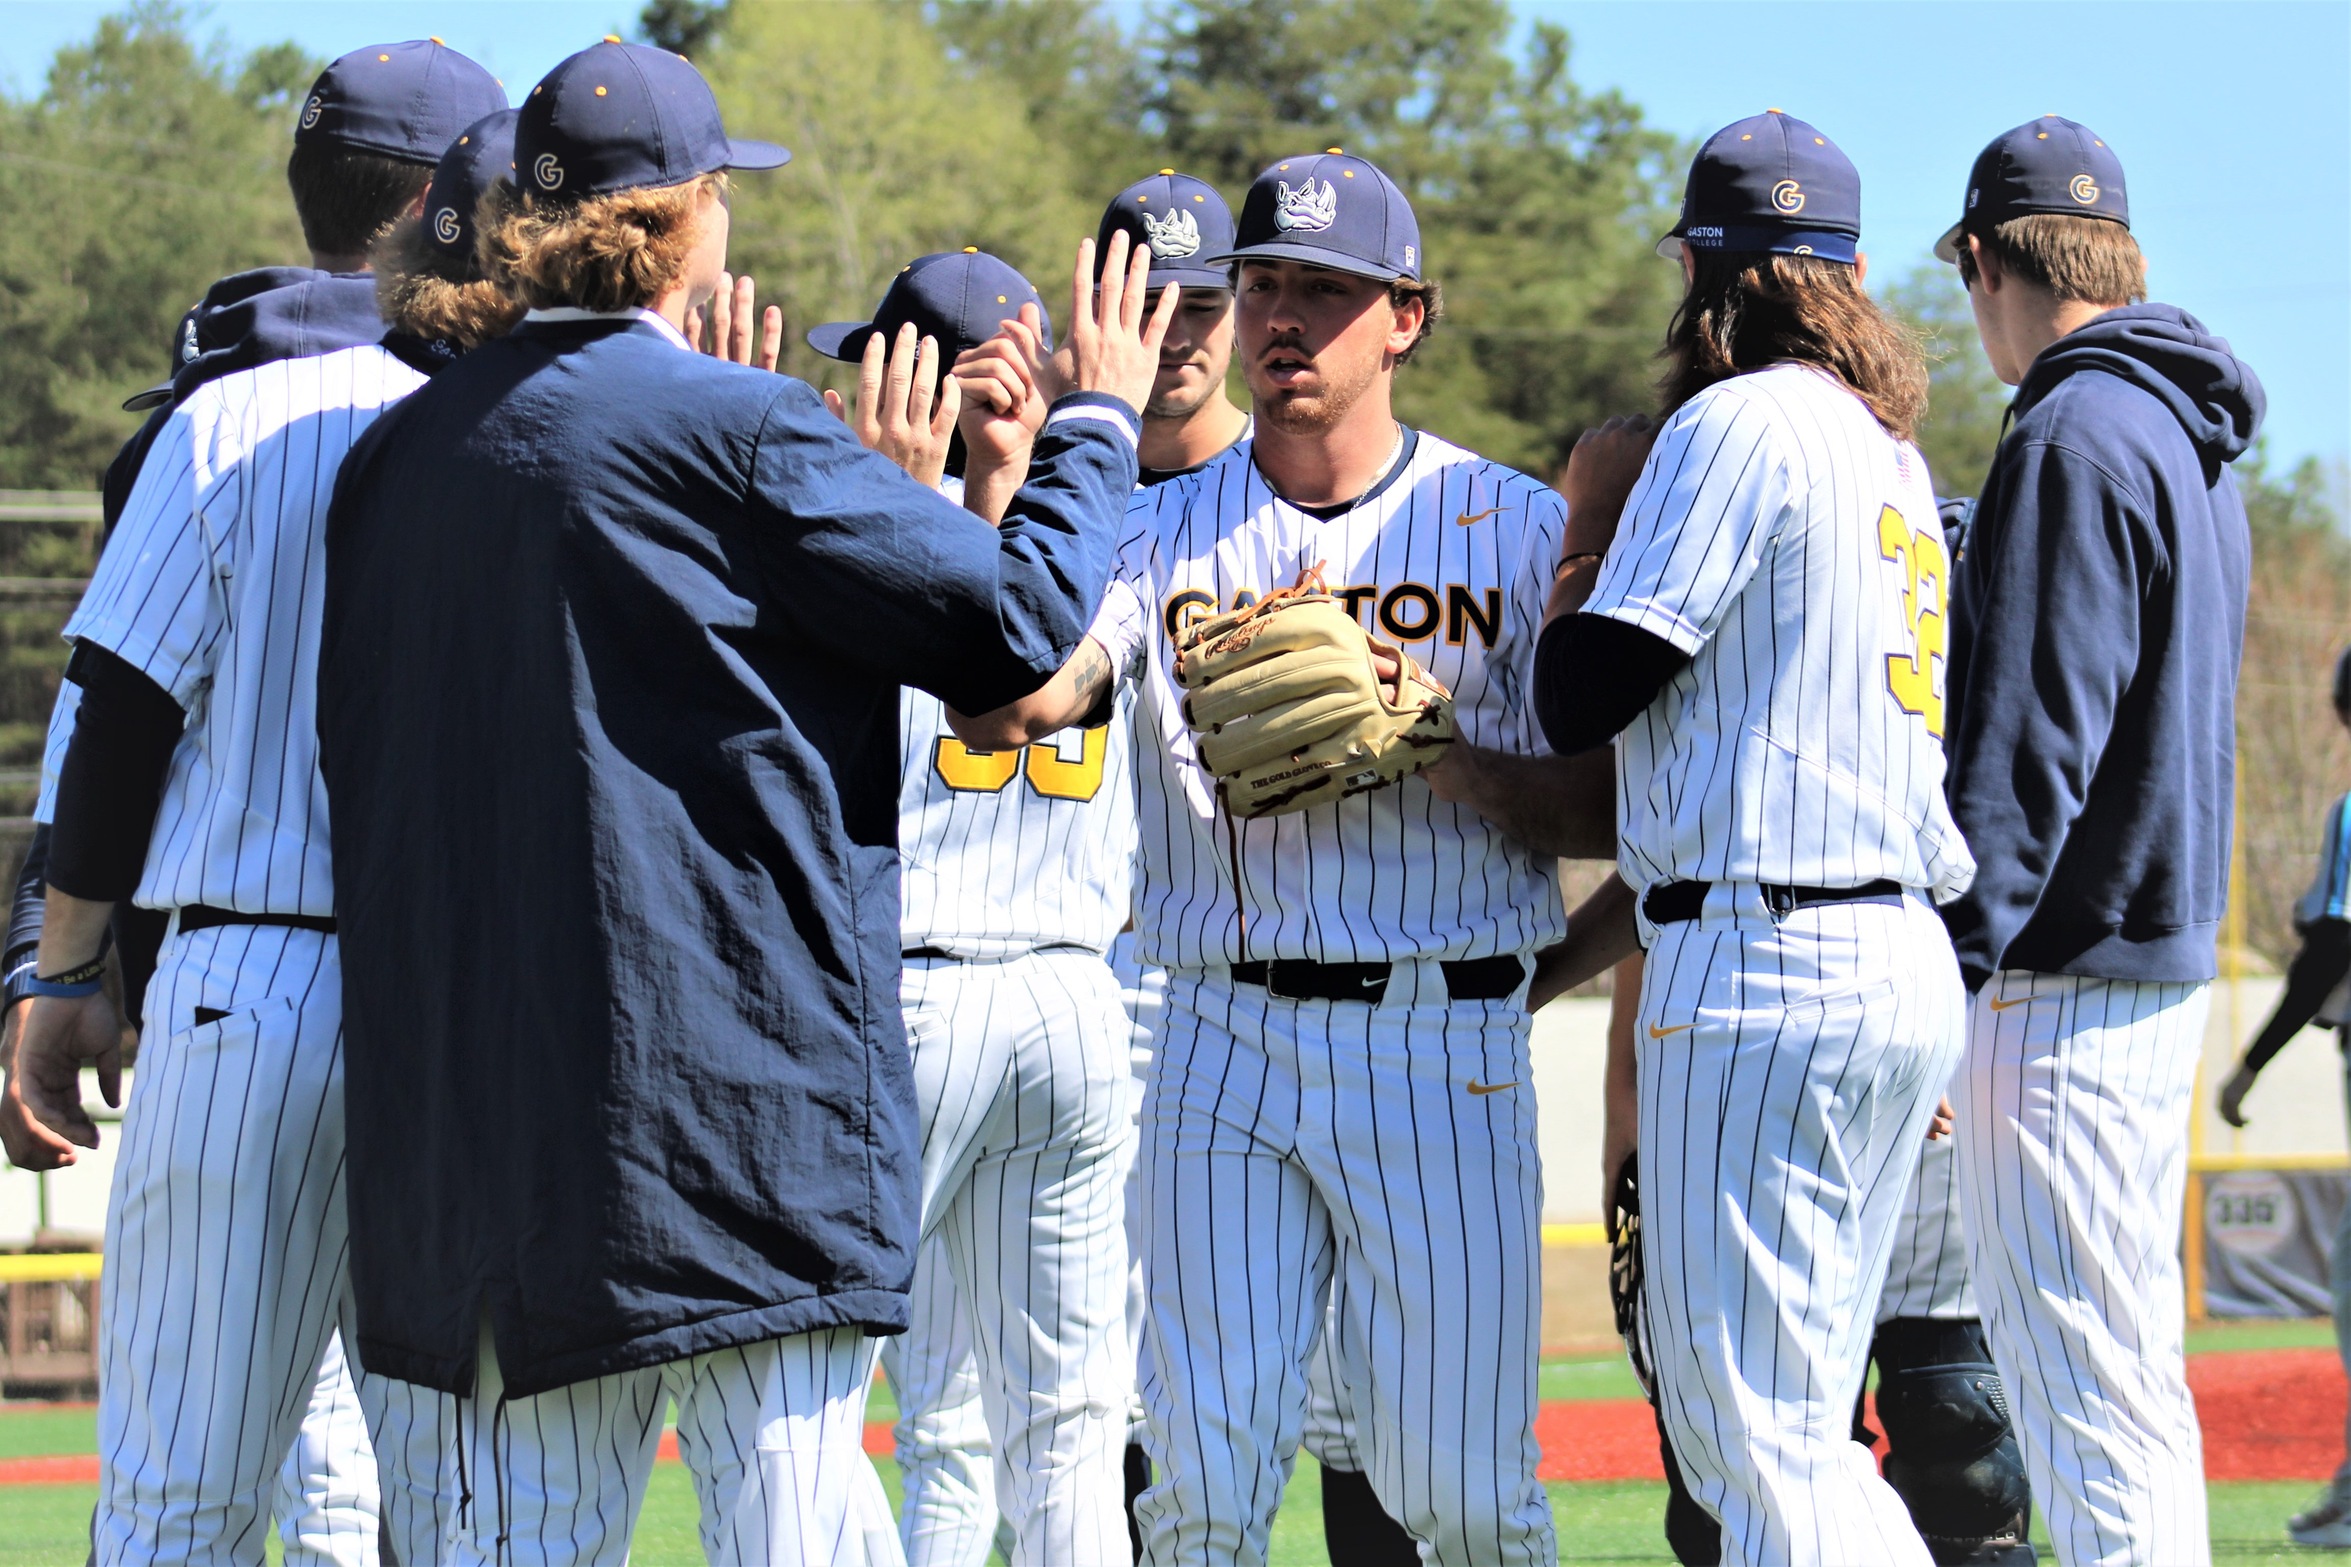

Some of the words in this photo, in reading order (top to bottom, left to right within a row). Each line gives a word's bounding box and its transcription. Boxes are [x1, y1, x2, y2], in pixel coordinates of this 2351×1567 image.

[302, 96, 322, 129] G
[534, 153, 564, 190] G
[1771, 179, 1805, 214] G
[2069, 174, 2100, 205] G
[434, 207, 460, 244] G
[1687, 226, 1723, 238] GASTON
[1688, 239, 1723, 247] OLLEGE
[1164, 581, 1503, 650] GTON
[1250, 779, 1269, 789] THE
[1269, 771, 1292, 784] GOLD
[1292, 762, 1320, 777] GLOVE
